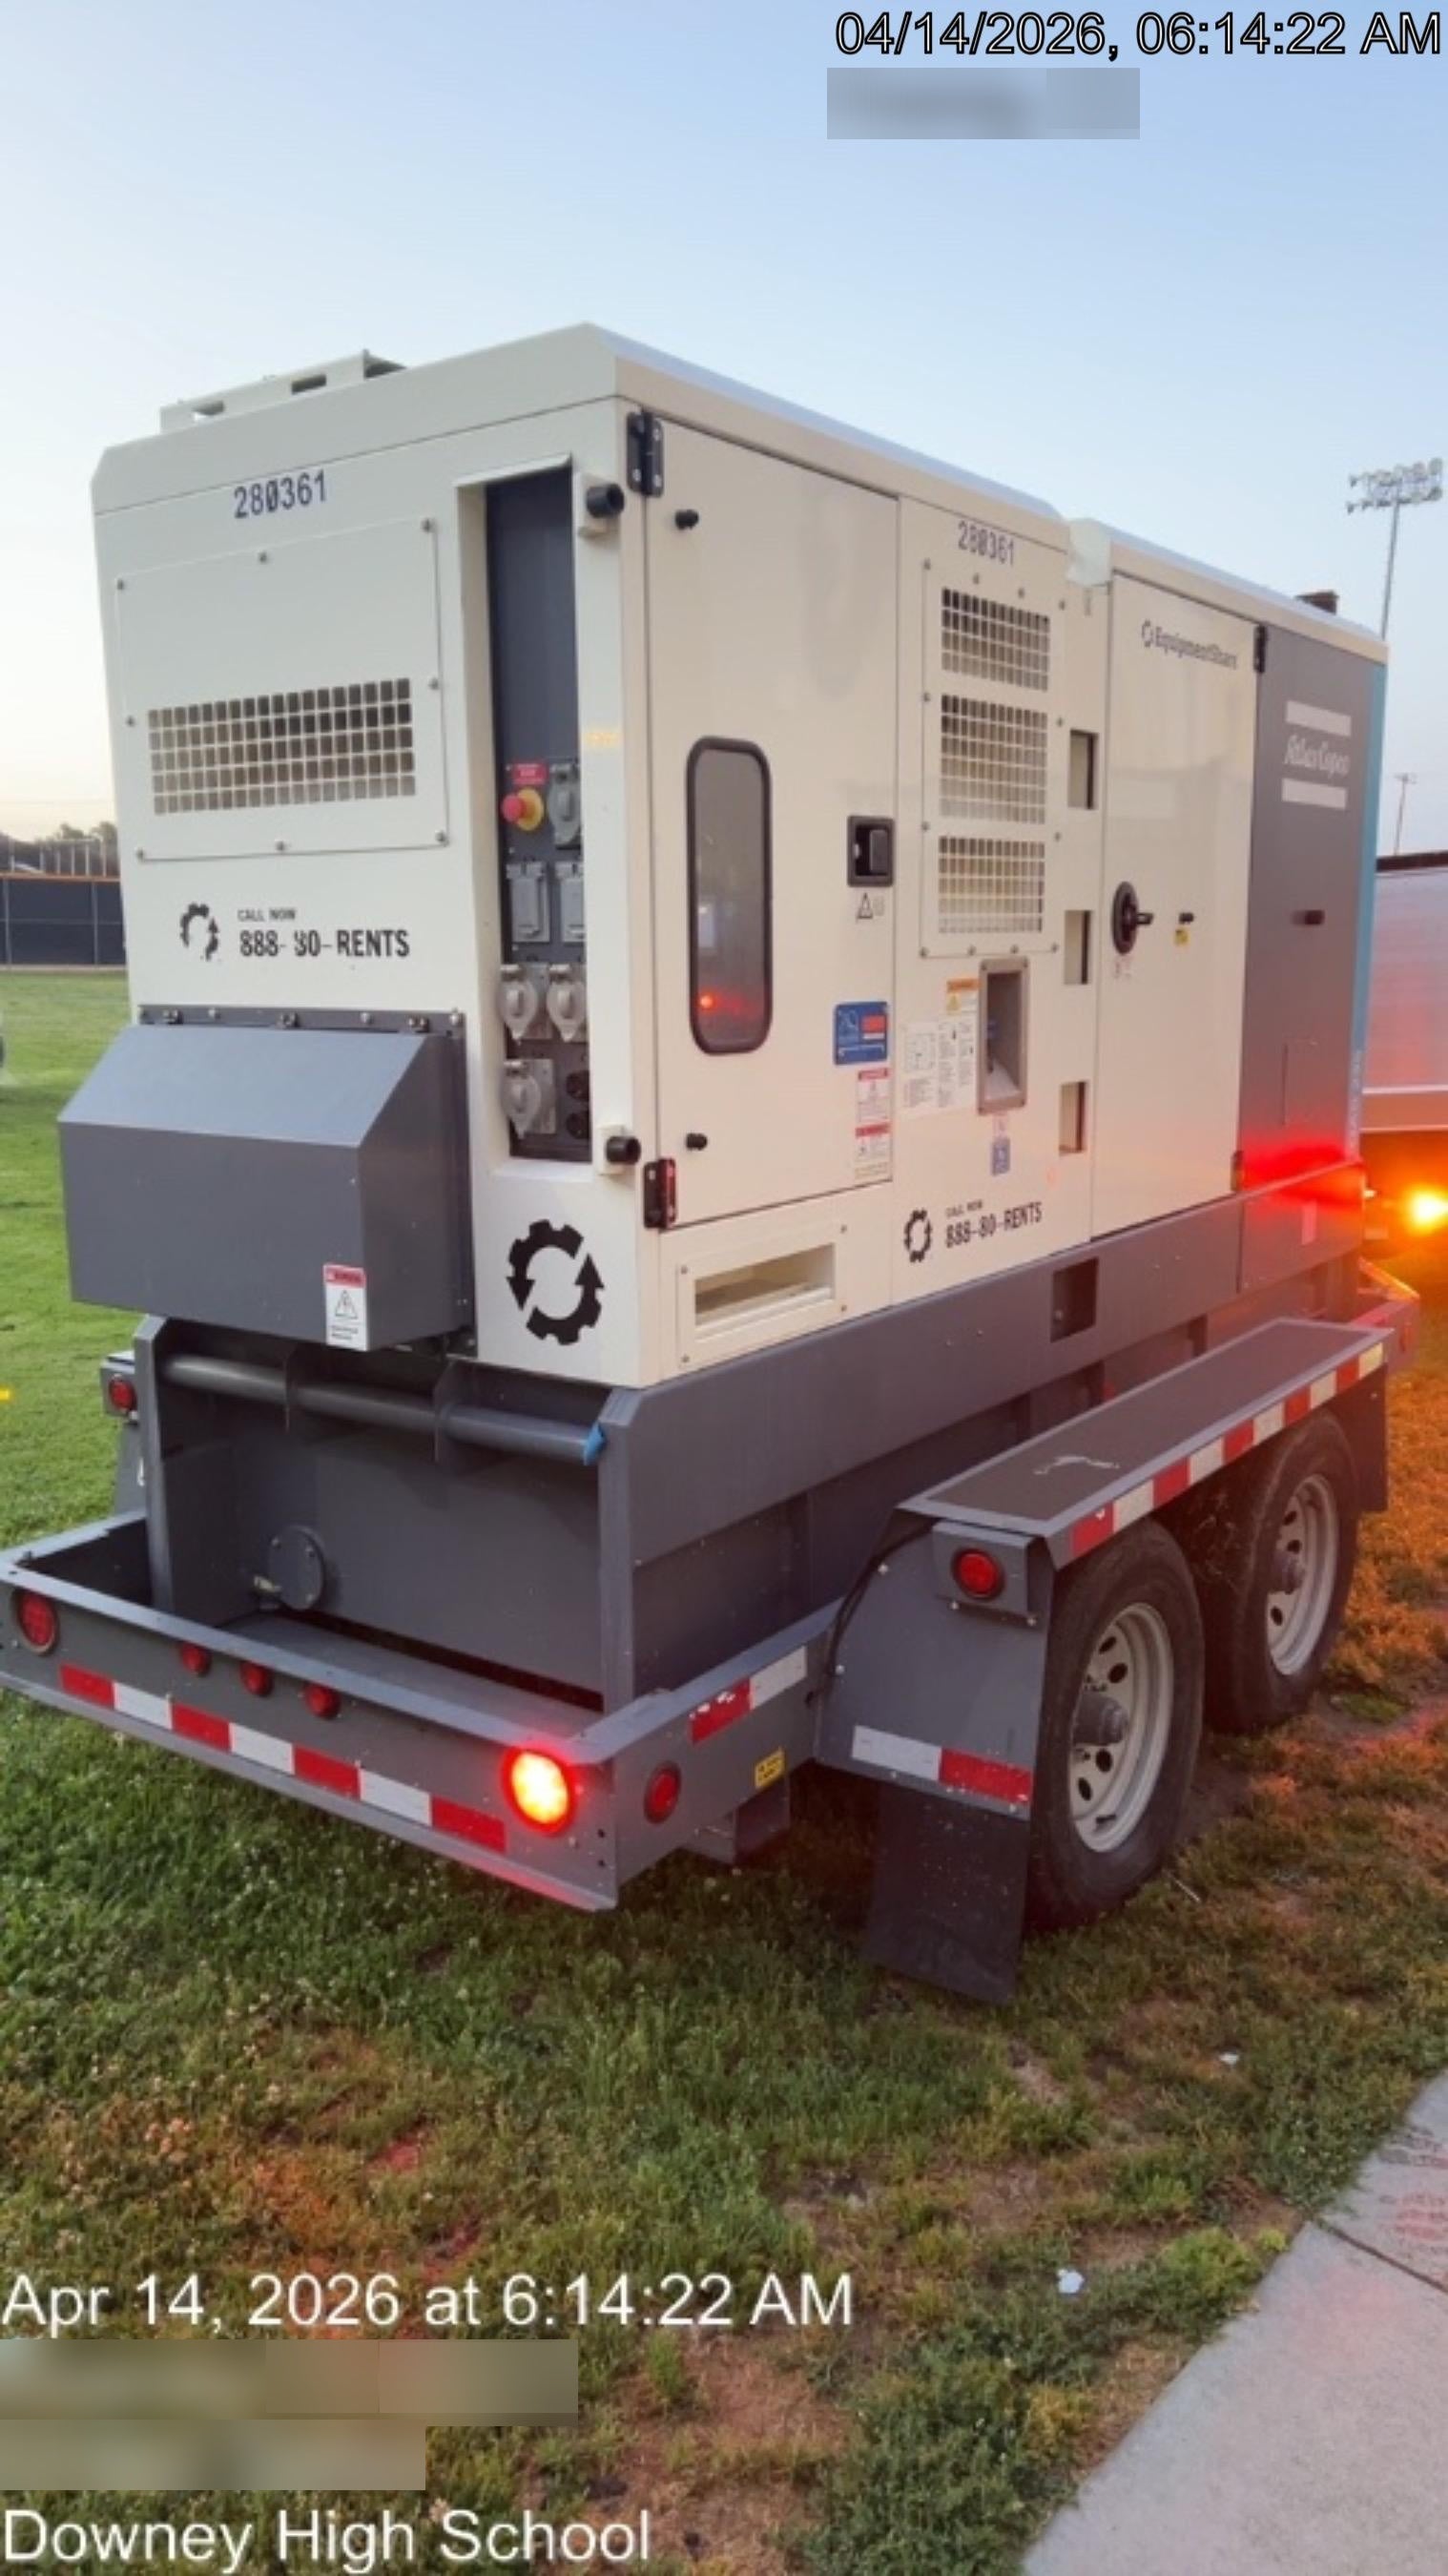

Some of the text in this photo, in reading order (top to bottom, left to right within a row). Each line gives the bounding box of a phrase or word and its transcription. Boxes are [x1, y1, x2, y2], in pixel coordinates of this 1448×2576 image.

[234, 468, 326, 518] 280361
[958, 521, 1014, 567] 280361
[238, 908, 296, 922] CALL NOW
[945, 1201, 1042, 1248] 888-80-RENTS
